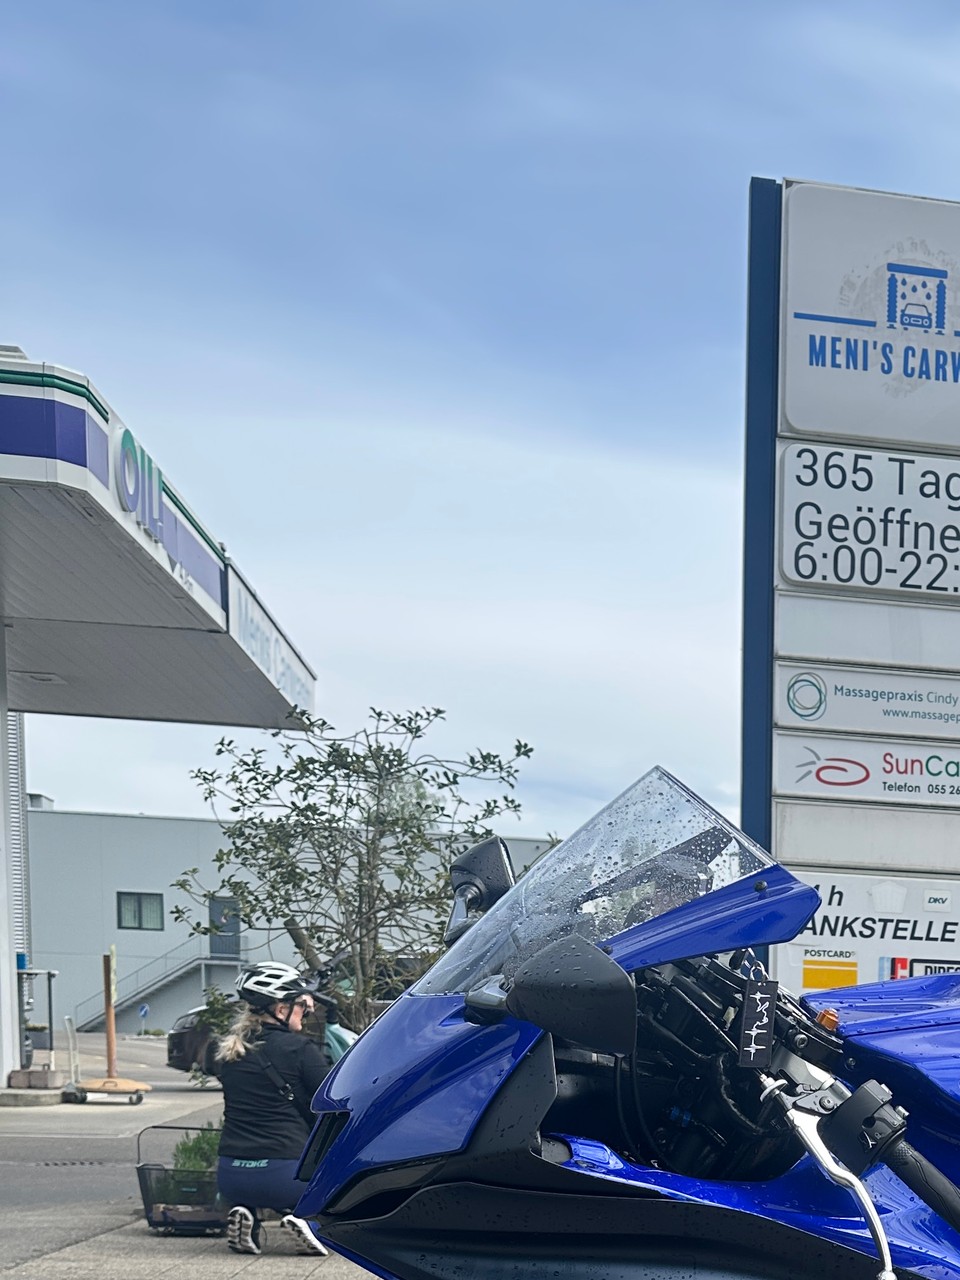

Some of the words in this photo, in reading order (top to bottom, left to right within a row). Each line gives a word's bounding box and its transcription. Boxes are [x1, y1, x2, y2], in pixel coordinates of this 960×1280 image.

[808, 334, 894, 376] MENI'S
[795, 448, 874, 493] 365
[834, 684, 924, 703] Massagepraxis
[926, 691, 959, 707] Cindy
[882, 781, 921, 793] Telefon
[927, 784, 947, 795] 055
[928, 896, 948, 904] DKV
[799, 914, 959, 943] ANKSTELLE
